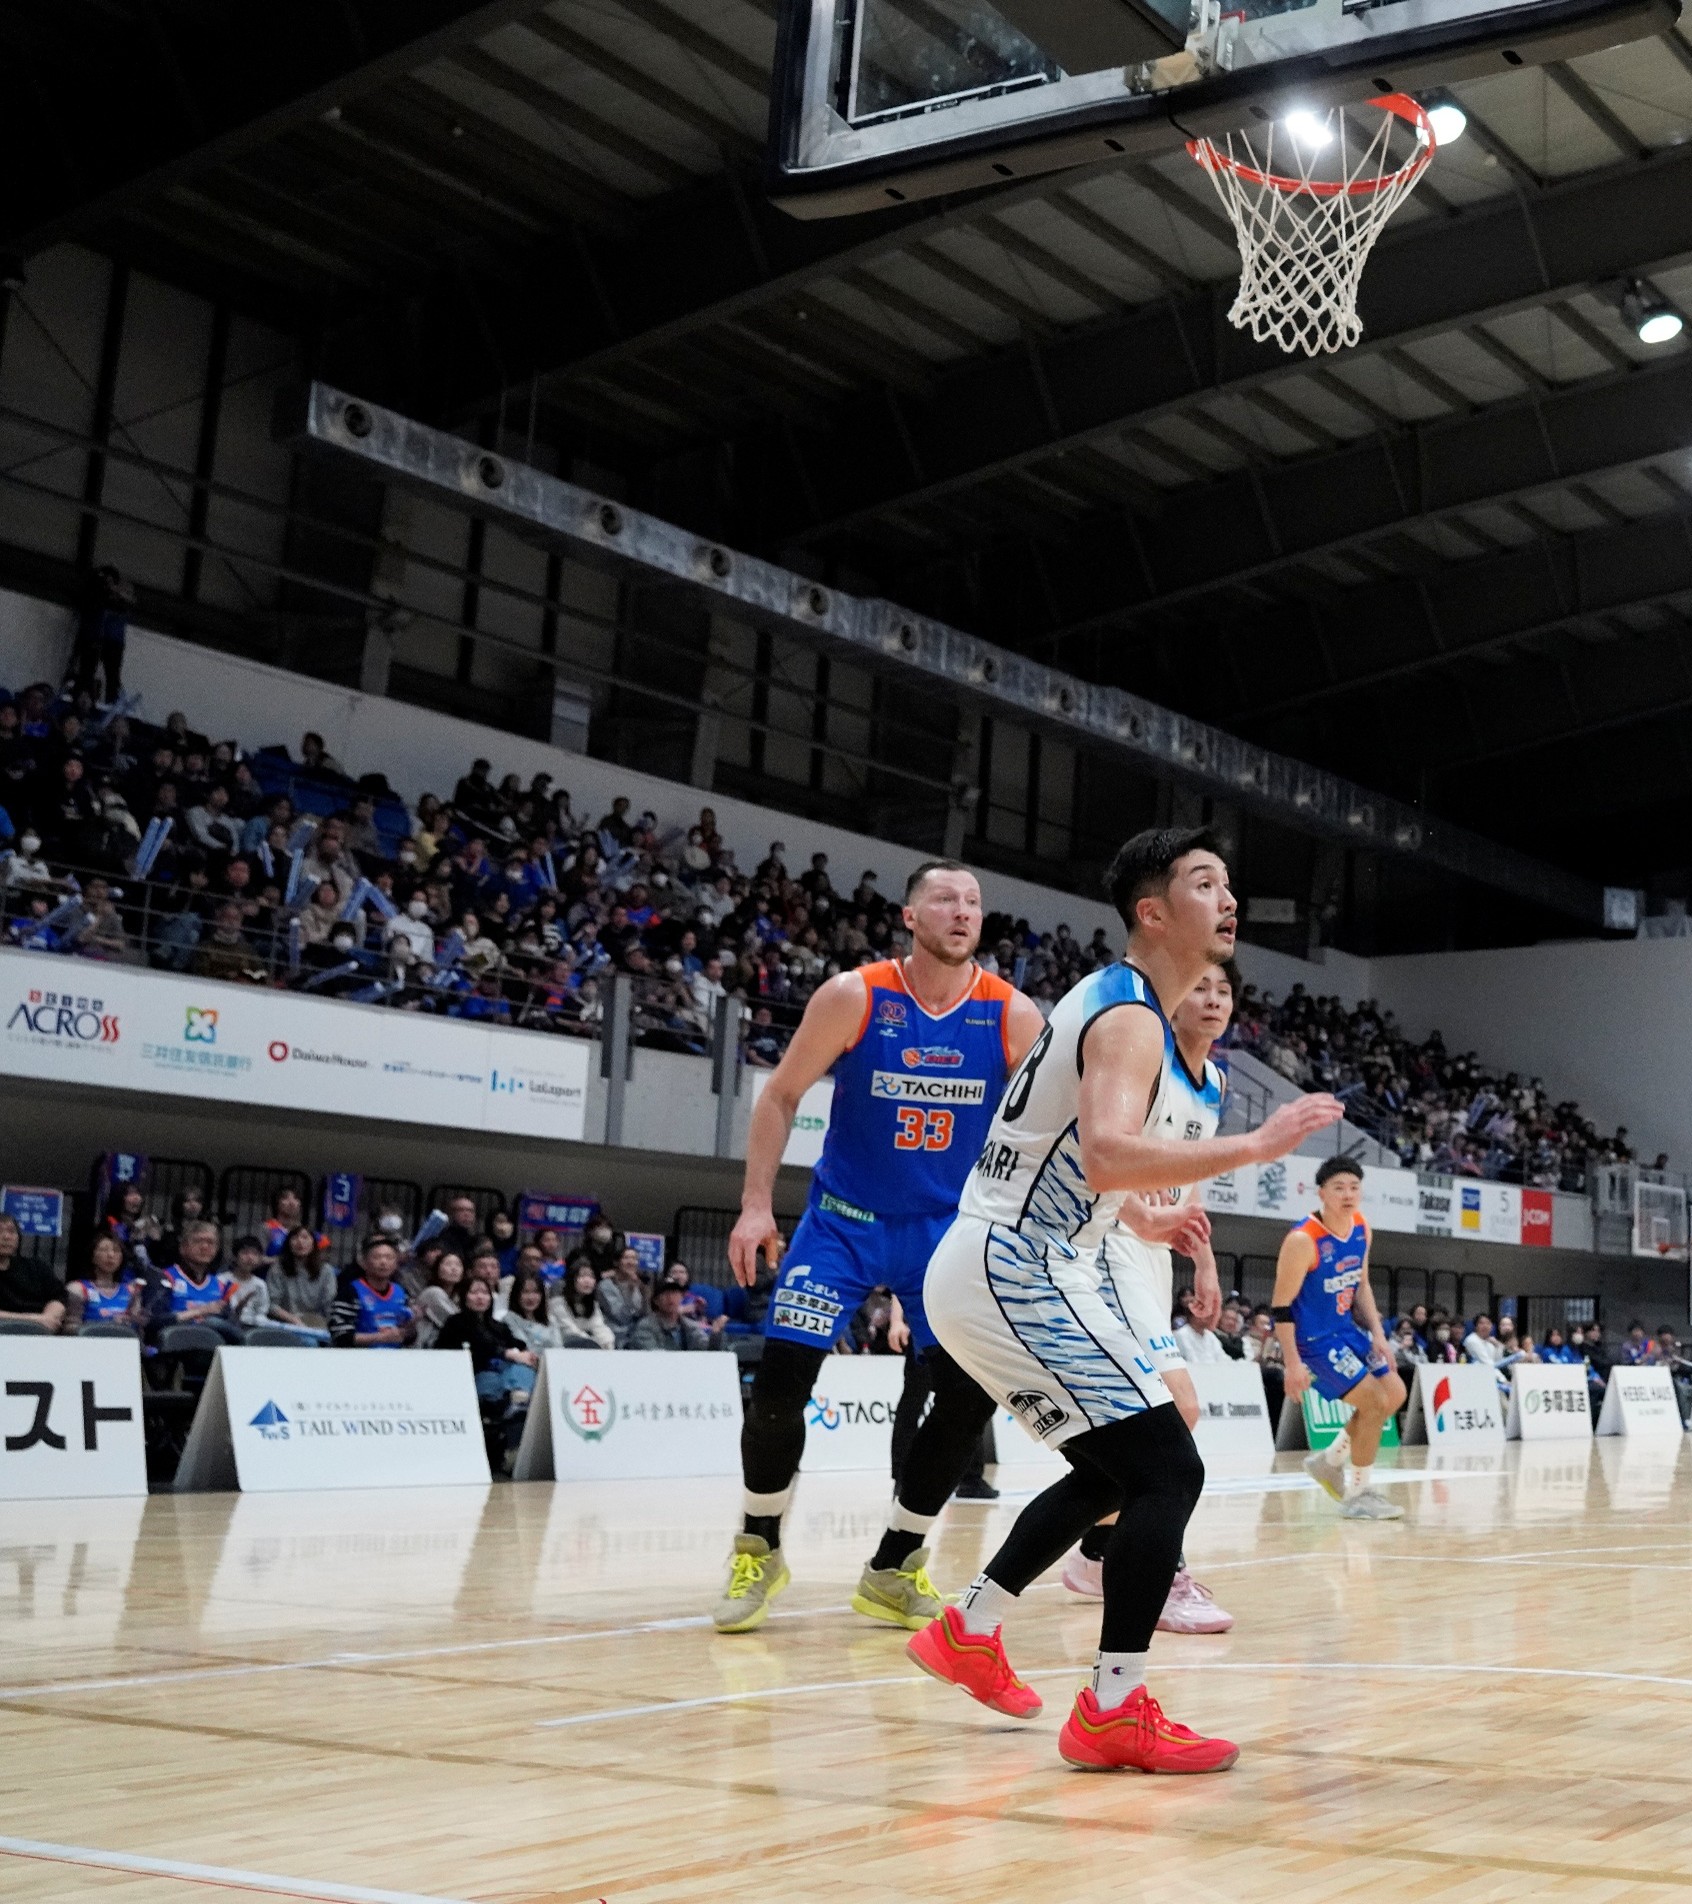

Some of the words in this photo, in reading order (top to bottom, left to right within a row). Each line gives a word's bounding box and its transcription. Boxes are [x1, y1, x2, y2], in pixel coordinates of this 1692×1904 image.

[902, 1080, 983, 1099] TACHIHI
[894, 1106, 955, 1152] 33
[793, 1312, 832, 1334] リスト
[1542, 1389, 1587, 1414] 多摩運送
[299, 1420, 339, 1437] TAIL
[342, 1420, 393, 1436] WIND
[397, 1419, 467, 1436] SYSTEM
[1454, 1409, 1496, 1431] たましん
